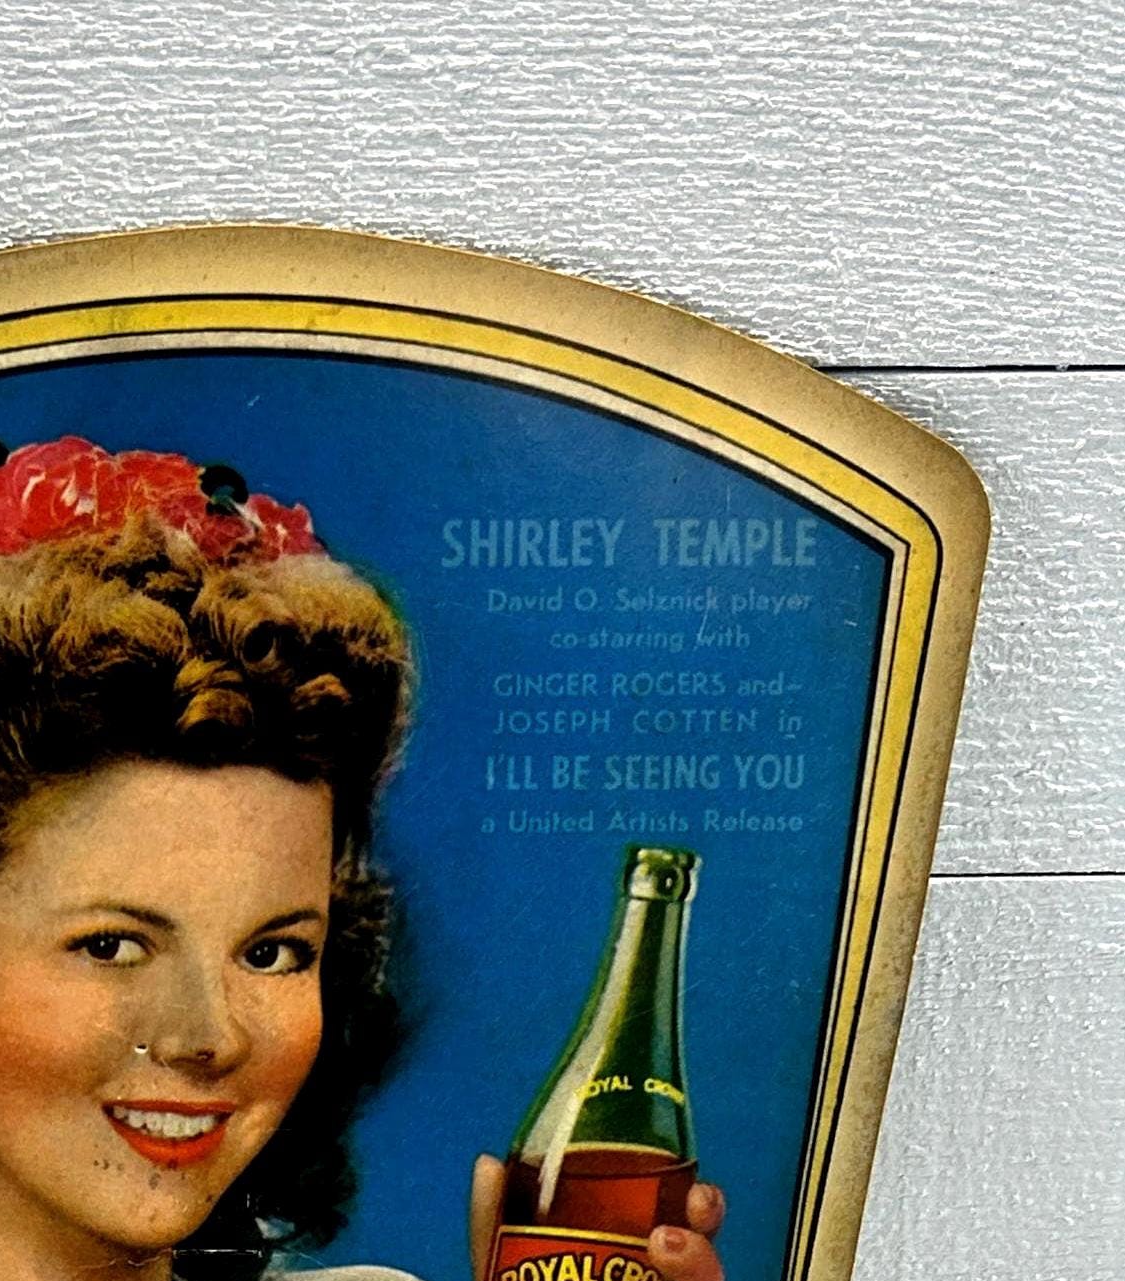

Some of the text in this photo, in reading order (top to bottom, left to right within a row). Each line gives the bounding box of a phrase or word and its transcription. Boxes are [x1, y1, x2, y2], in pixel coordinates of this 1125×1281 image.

[440, 518, 819, 569] SHIRLEY TEMPLE
[486, 586, 563, 613] David
[616, 586, 716, 613] Selznick
[731, 586, 814, 616] player
[549, 624, 751, 654] co-starring with
[493, 673, 598, 698] GINGER
[611, 672, 726, 698] ROGERS
[493, 708, 802, 735] JOSEPH COTTEN in
[485, 753, 806, 792] I'LL BE SEEING YOU
[481, 809, 804, 834] a United Artists Release
